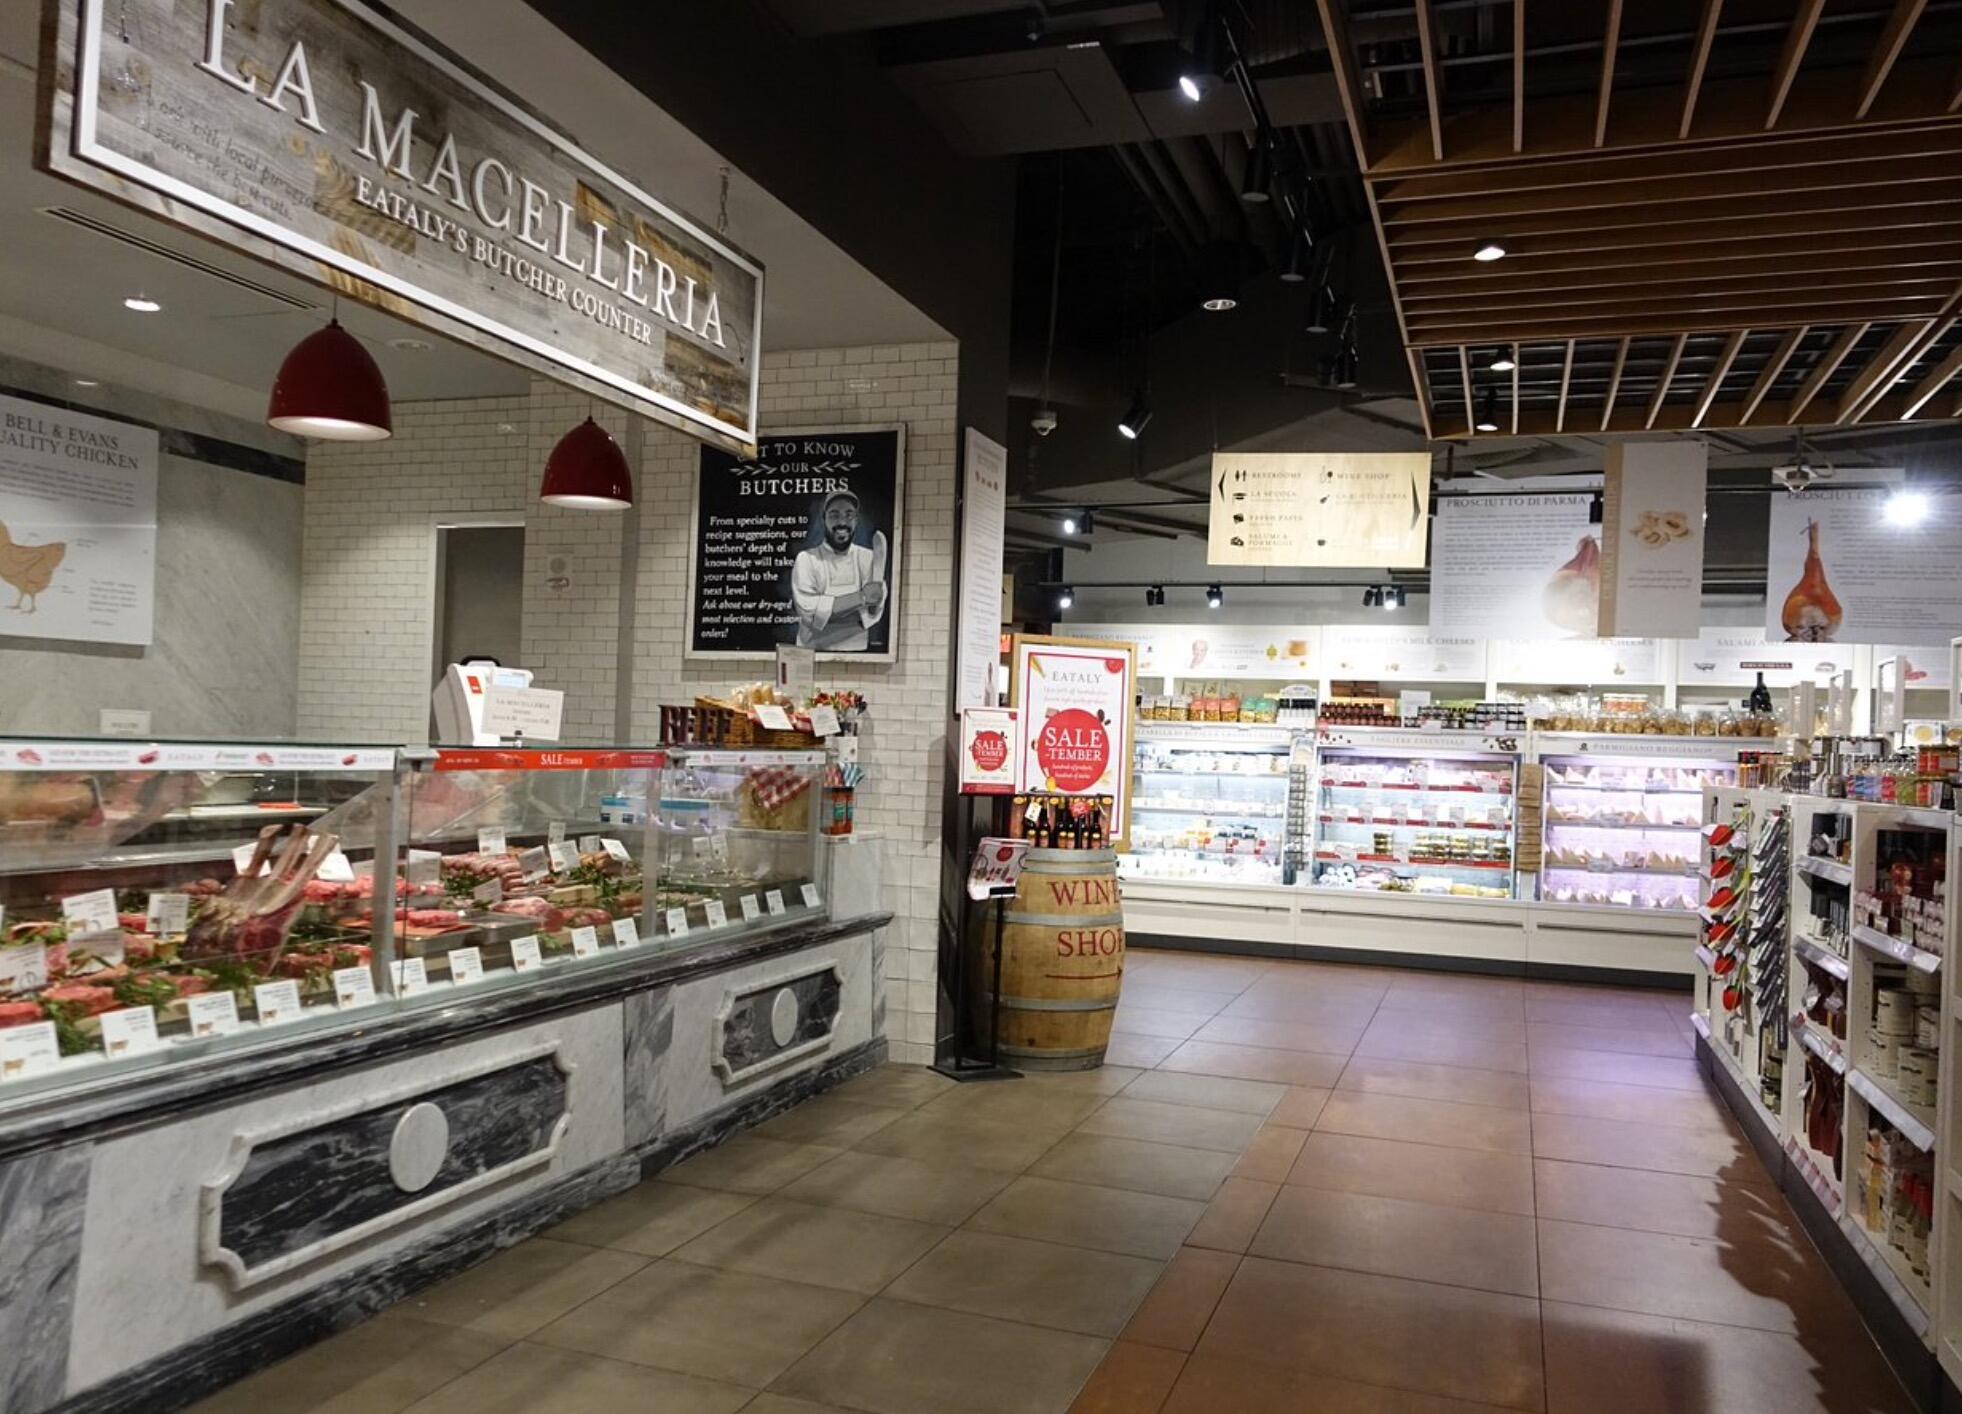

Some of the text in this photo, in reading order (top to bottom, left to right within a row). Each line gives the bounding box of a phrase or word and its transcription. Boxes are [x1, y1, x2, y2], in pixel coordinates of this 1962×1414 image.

[194, 0, 727, 349] LA MACELLERIA
[355, 175, 652, 346] EATALY'S BUTCHER COUNTER
[5, 413, 119, 450] BELL & EVANS
[774, 442, 797, 456] TO
[804, 441, 855, 458] KNOW
[64, 443, 138, 470] CHICKEN
[780, 463, 809, 473] OUR
[1365, 473, 1390, 481] SHOP
[740, 477, 849, 495] BUTCHERS
[1447, 496, 1586, 509] PROSCIUTTO DI PARMA
[709, 515, 809, 528] From specialty cuts to
[705, 531, 733, 541] recipe
[791, 530, 808, 539] our
[705, 542, 787, 555] butchers' depth of
[704, 556, 794, 568] knowledge will take
[703, 570, 779, 583] your meal to the
[703, 585, 750, 596] next level.
[702, 600, 793, 611] Ask about our dry-aged
[756, 613, 774, 624] and
[1053, 671, 1102, 684] EATALY
[1045, 726, 1103, 748] SALE
[975, 739, 1004, 751] SALE
[1593, 742, 1654, 753] PARMIGIANO
[541, 753, 563, 766] SALE
[1045, 747, 1103, 762] -TEMBER
